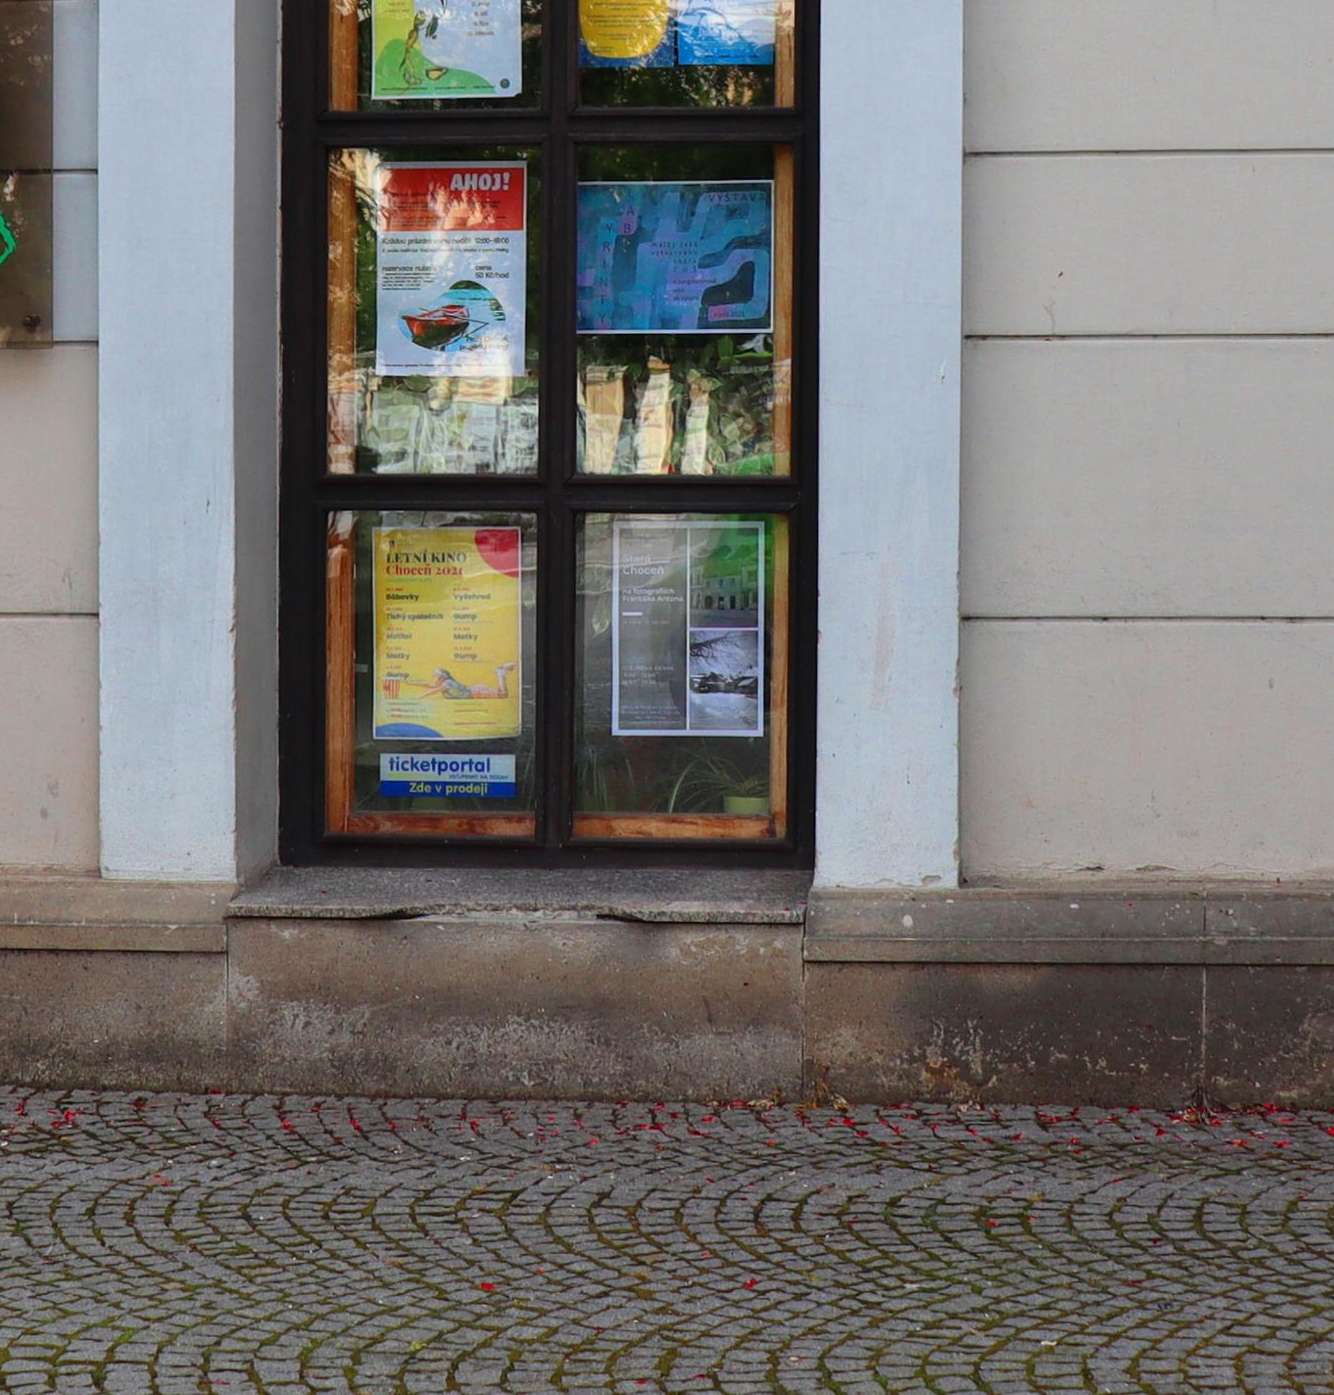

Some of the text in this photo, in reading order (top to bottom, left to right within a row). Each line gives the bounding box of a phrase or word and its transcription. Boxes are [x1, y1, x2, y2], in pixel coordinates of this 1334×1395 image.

[449, 171, 511, 192] AHOJ!
[430, 551, 468, 564] KINO
[385, 563, 432, 576] Choceň
[388, 755, 491, 776] ticketportal
[408, 782, 488, 797] Zde v prodeji
